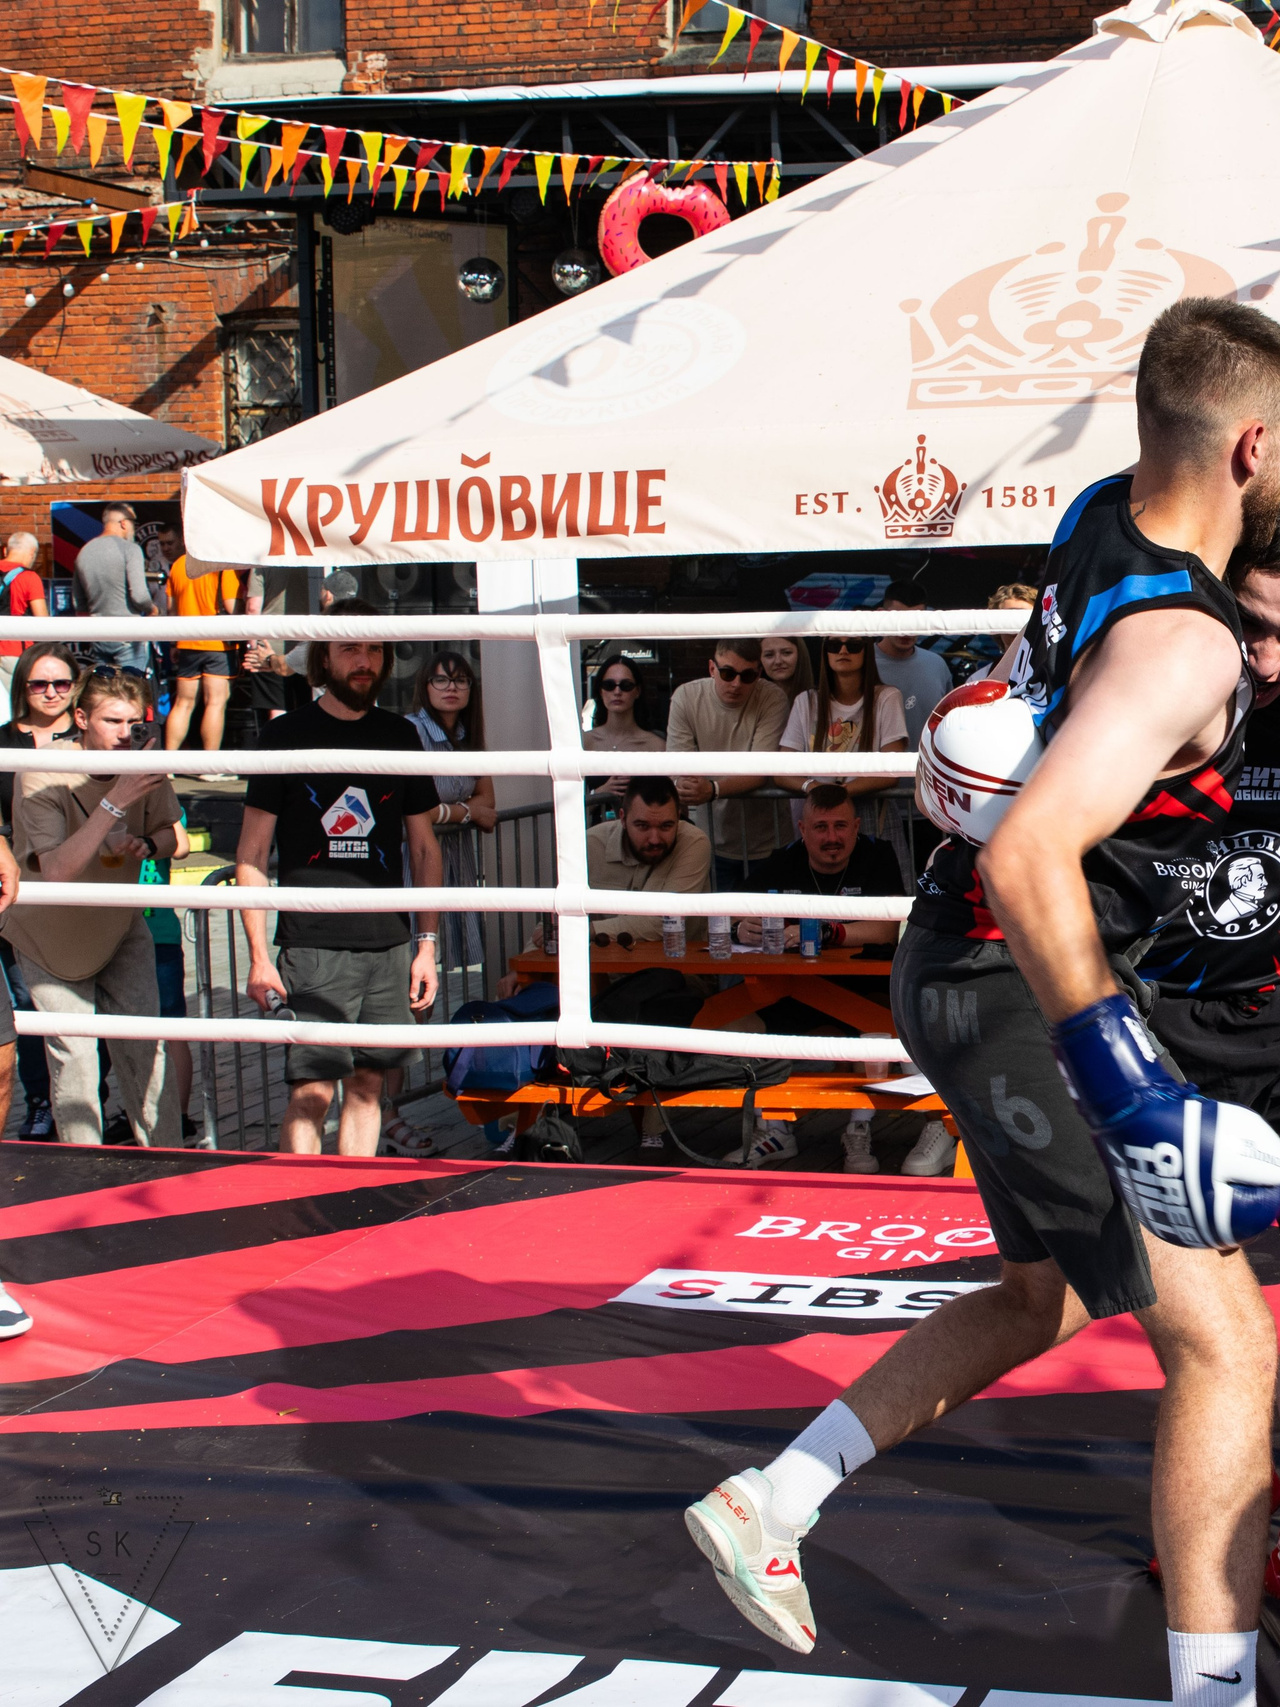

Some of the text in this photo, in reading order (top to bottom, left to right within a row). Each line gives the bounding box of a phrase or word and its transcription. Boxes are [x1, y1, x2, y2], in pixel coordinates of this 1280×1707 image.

[795, 485, 1056, 516] EST. 1581
[329, 840, 369, 852] БИТВА
[735, 1215, 995, 1247] BROO
[836, 1247, 944, 1262] GIN
